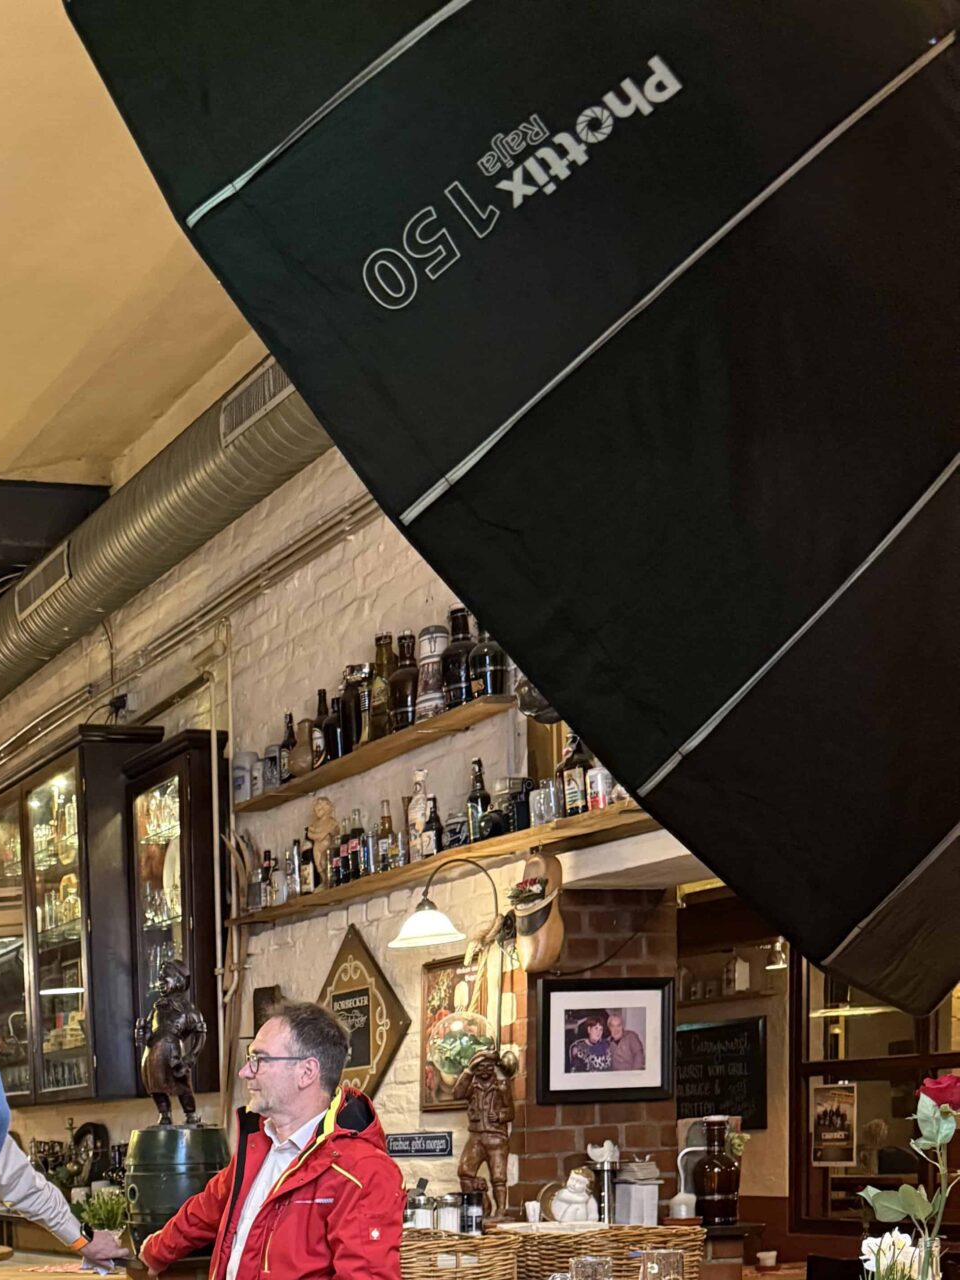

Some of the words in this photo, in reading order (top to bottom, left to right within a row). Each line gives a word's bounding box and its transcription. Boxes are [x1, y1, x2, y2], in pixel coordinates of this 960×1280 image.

[477, 114, 550, 177] Raja
[495, 55, 682, 209] Phottix
[363, 181, 500, 310] 150
